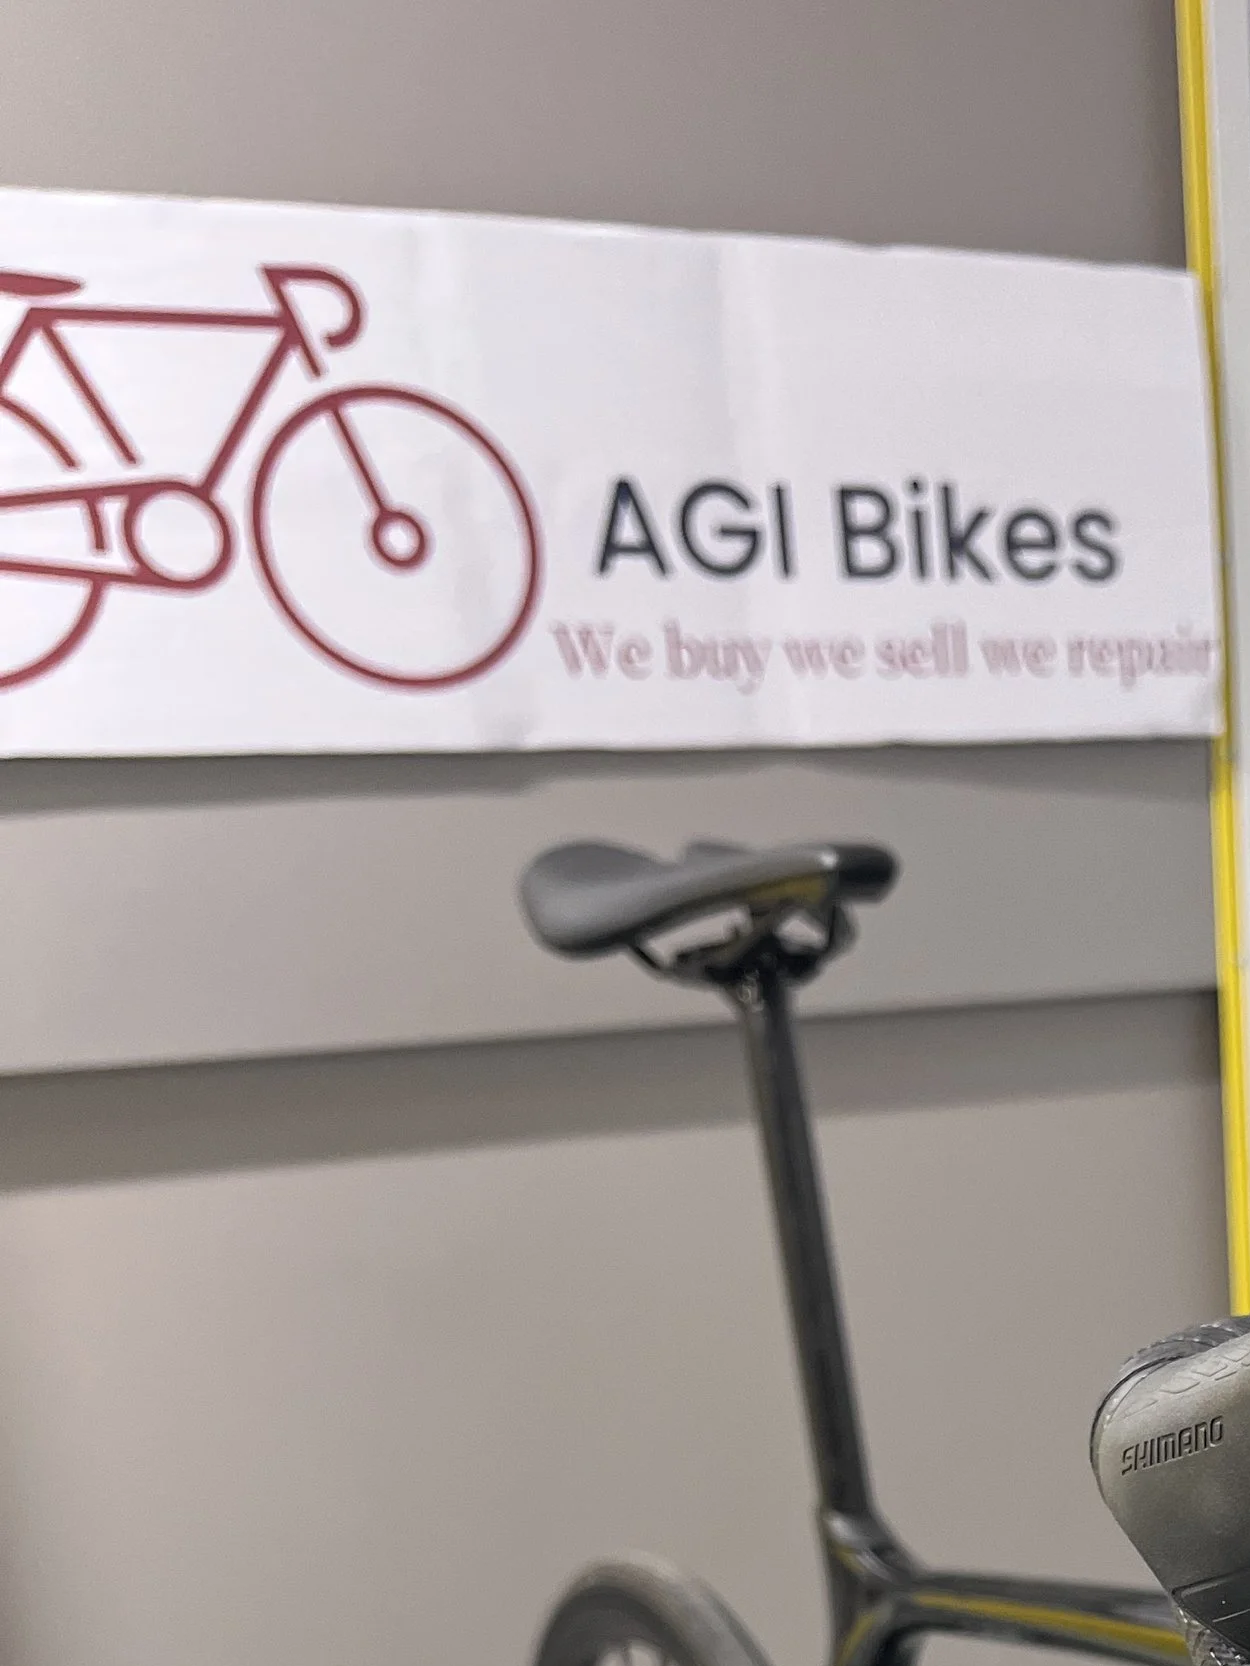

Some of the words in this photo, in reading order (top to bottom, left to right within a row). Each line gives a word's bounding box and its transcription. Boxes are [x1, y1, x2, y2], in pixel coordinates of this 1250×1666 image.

[595, 475, 797, 582] AGI
[833, 475, 1122, 584] Bikes
[551, 622, 652, 680] We
[663, 617, 770, 694] buy
[779, 638, 865, 680] we
[874, 618, 968, 682] sell
[976, 637, 1058, 680] we
[1065, 618, 1216, 688] repair
[1120, 1414, 1225, 1476] SHIMANO
